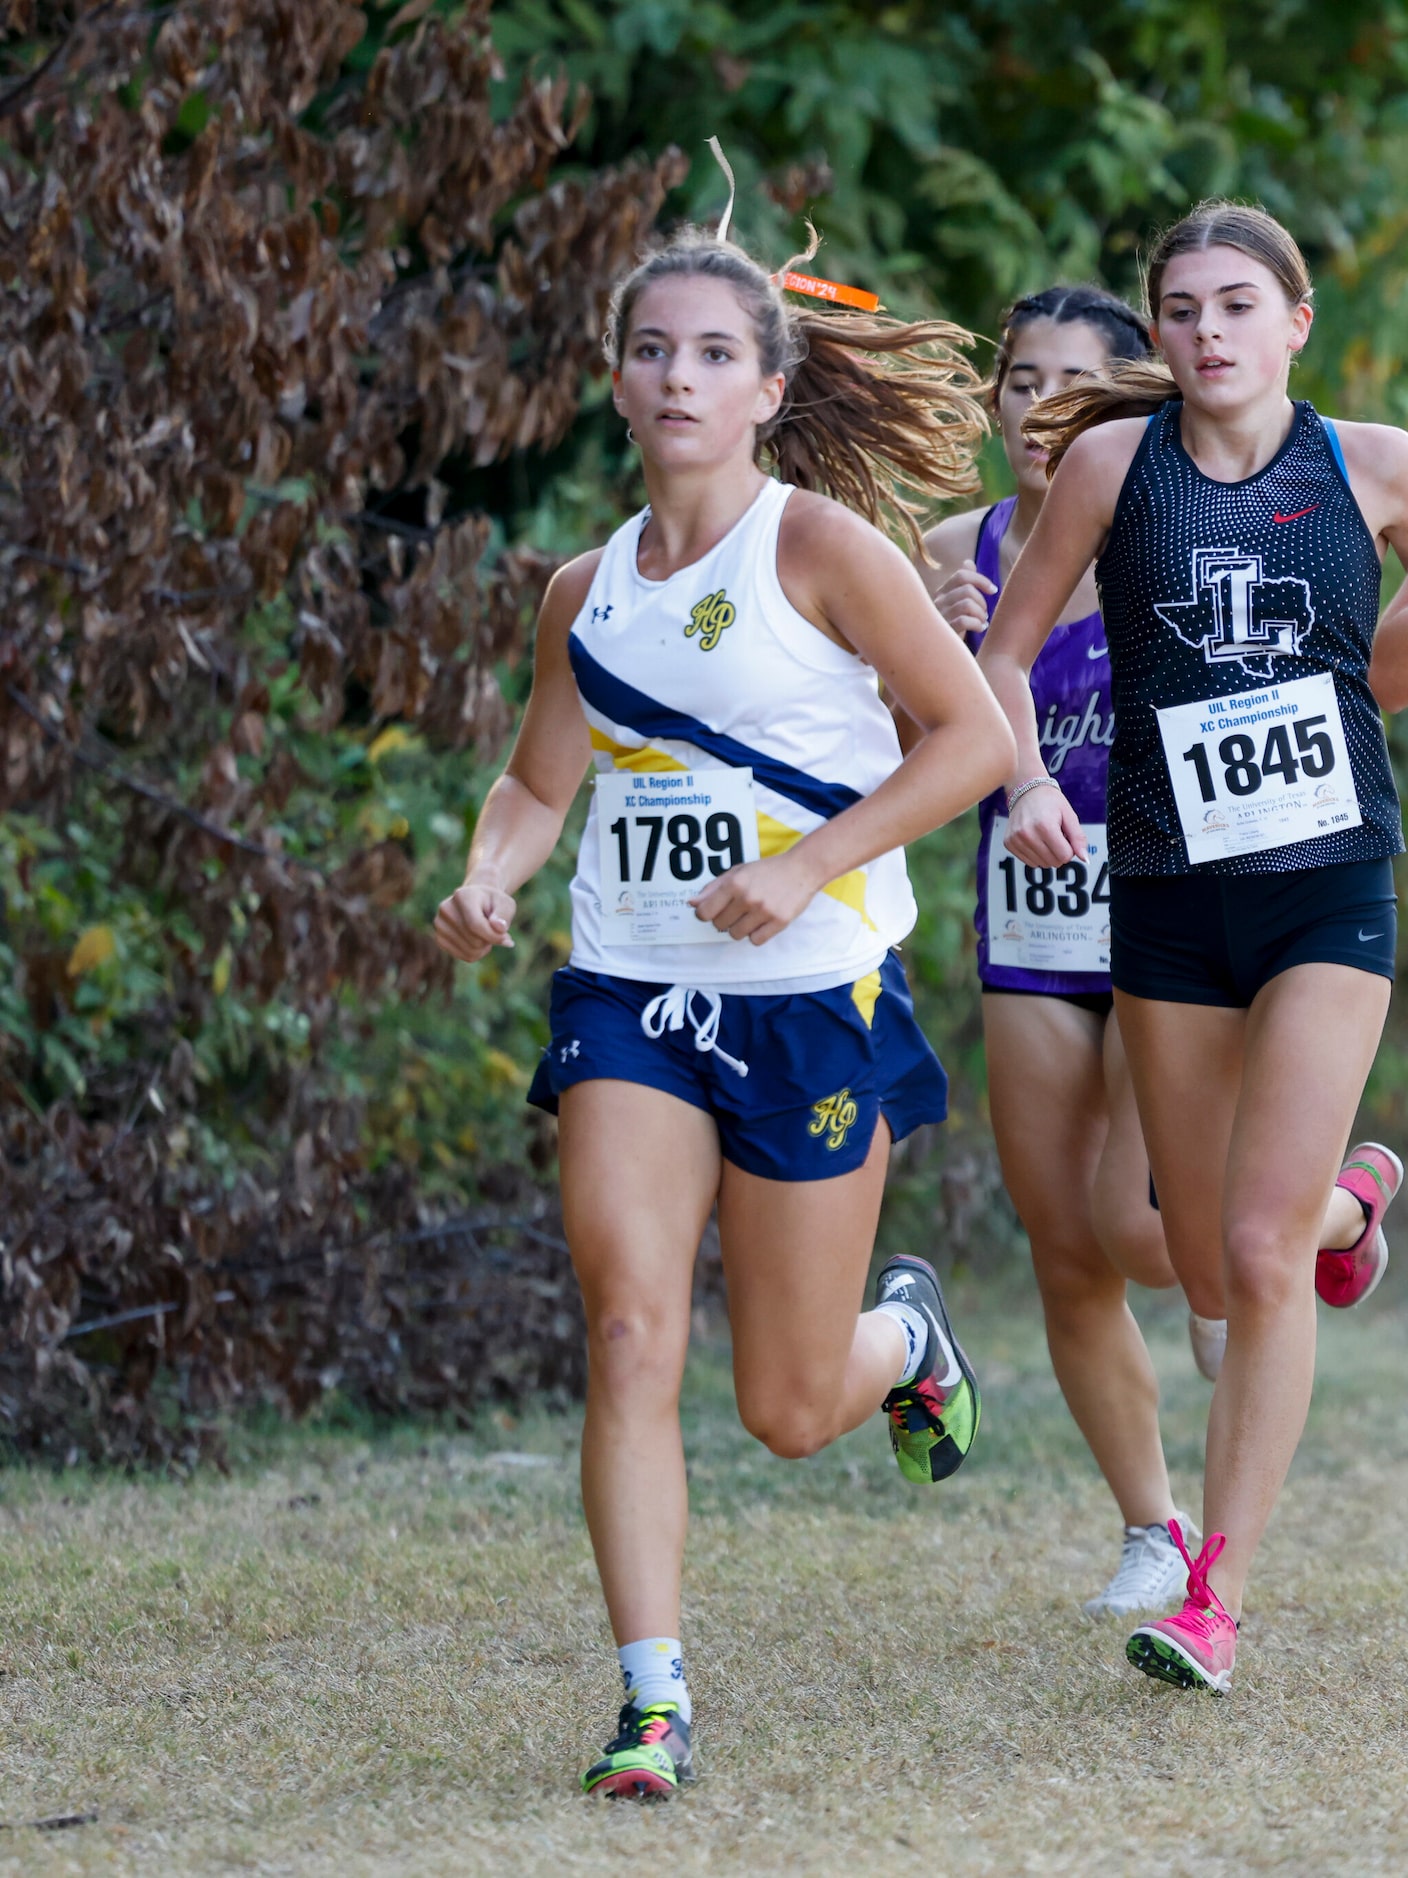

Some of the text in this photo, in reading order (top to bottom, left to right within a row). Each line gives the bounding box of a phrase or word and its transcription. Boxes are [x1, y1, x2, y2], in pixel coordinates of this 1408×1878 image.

[784, 272, 816, 293] EGION
[684, 589, 735, 652] HP
[1208, 689, 1280, 715] UIL Region II
[1200, 703, 1299, 733] XC Championship
[1183, 714, 1335, 803] 1845
[633, 777, 647, 789] UIL
[649, 776, 683, 791] Region
[625, 793, 712, 809] XC Championship
[1242, 798, 1276, 810] University
[1317, 813, 1349, 828] No. 1845
[610, 812, 744, 883] 1789
[998, 856, 1111, 917] 1834
[1030, 931, 1088, 941] ARLINGTON
[807, 1087, 859, 1151] HP
